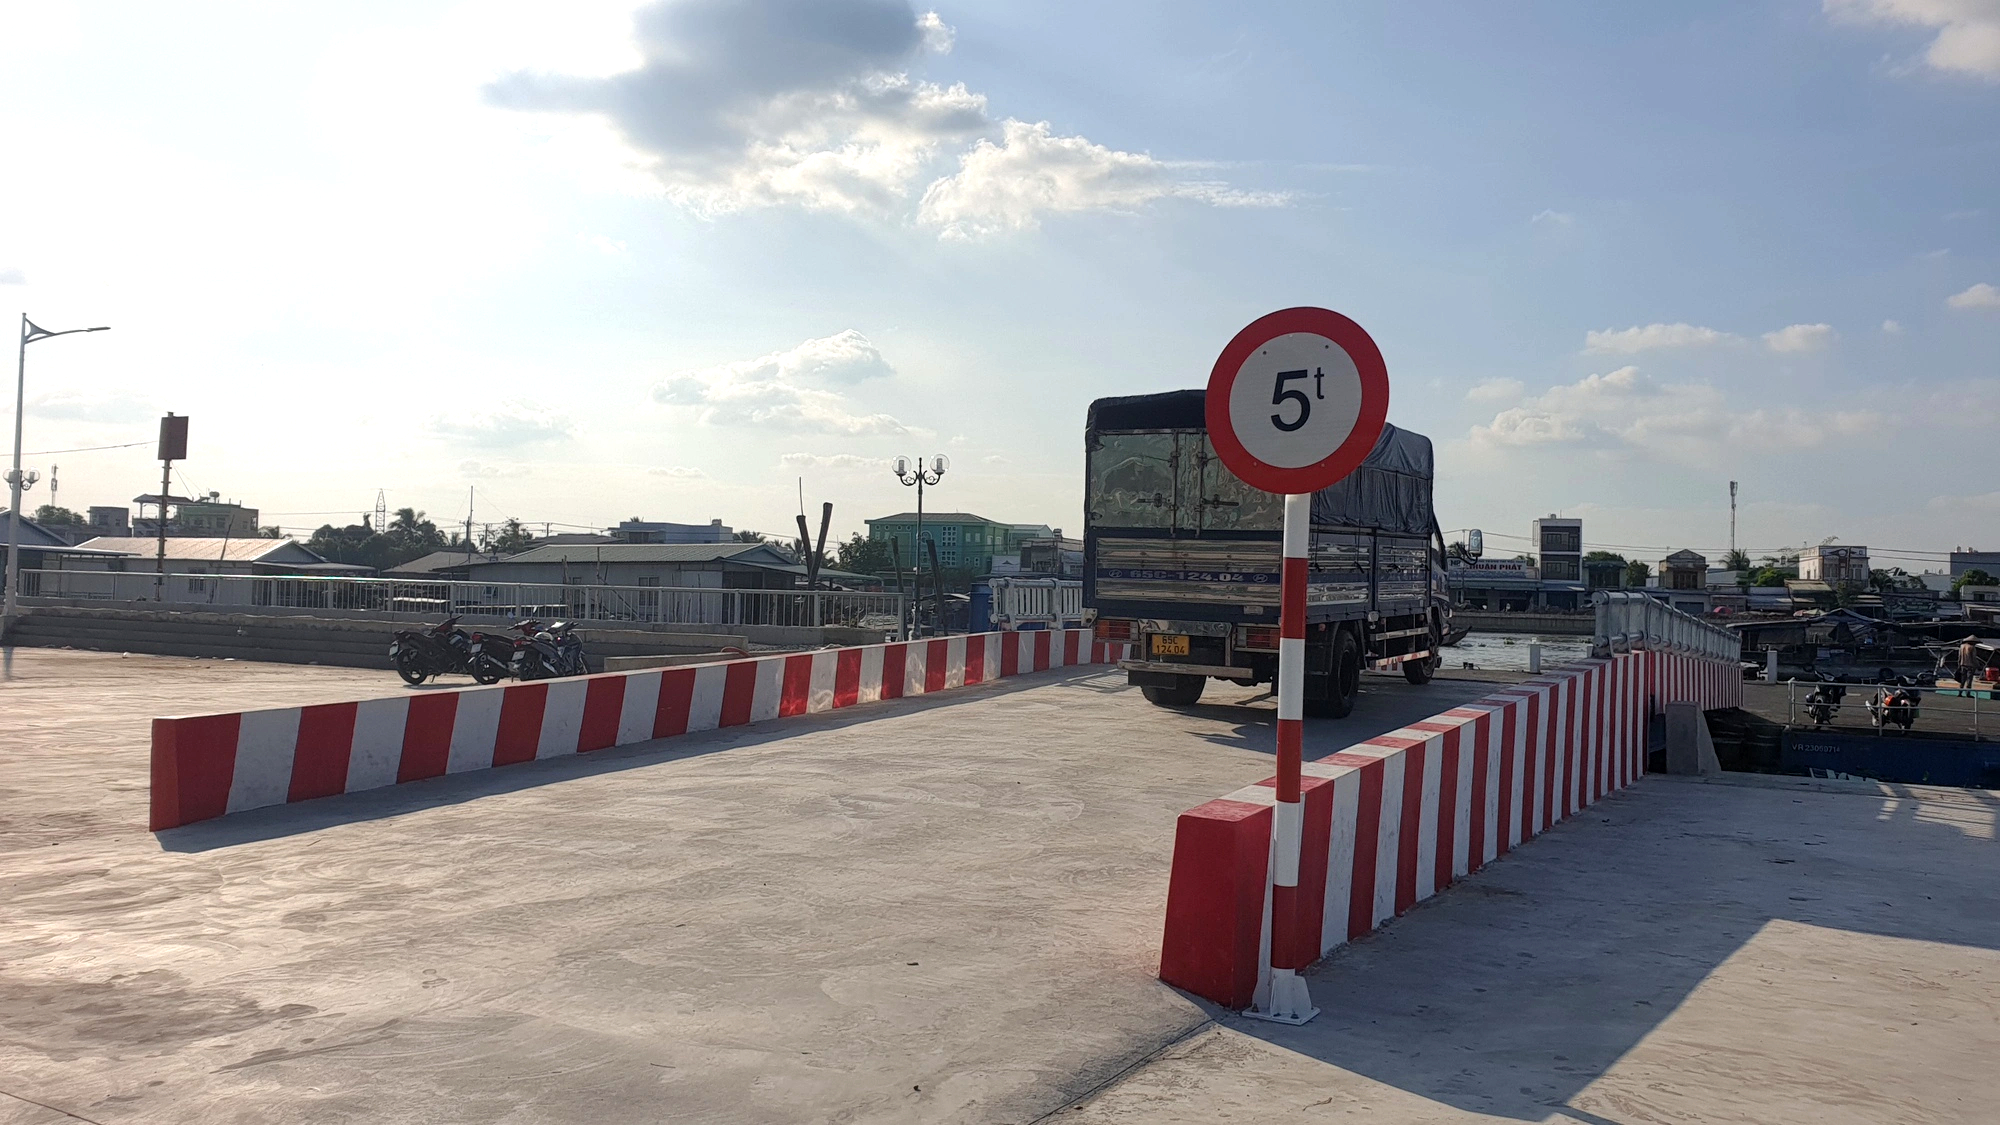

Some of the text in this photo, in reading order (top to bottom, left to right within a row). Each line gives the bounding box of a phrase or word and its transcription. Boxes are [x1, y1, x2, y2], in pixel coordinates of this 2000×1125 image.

[1271, 367, 1325, 432] 5t
[1130, 570, 1245, 582] 65C-124.04
[1162, 635, 1178, 644] 65C
[1156, 644, 1185, 654] 124.04
